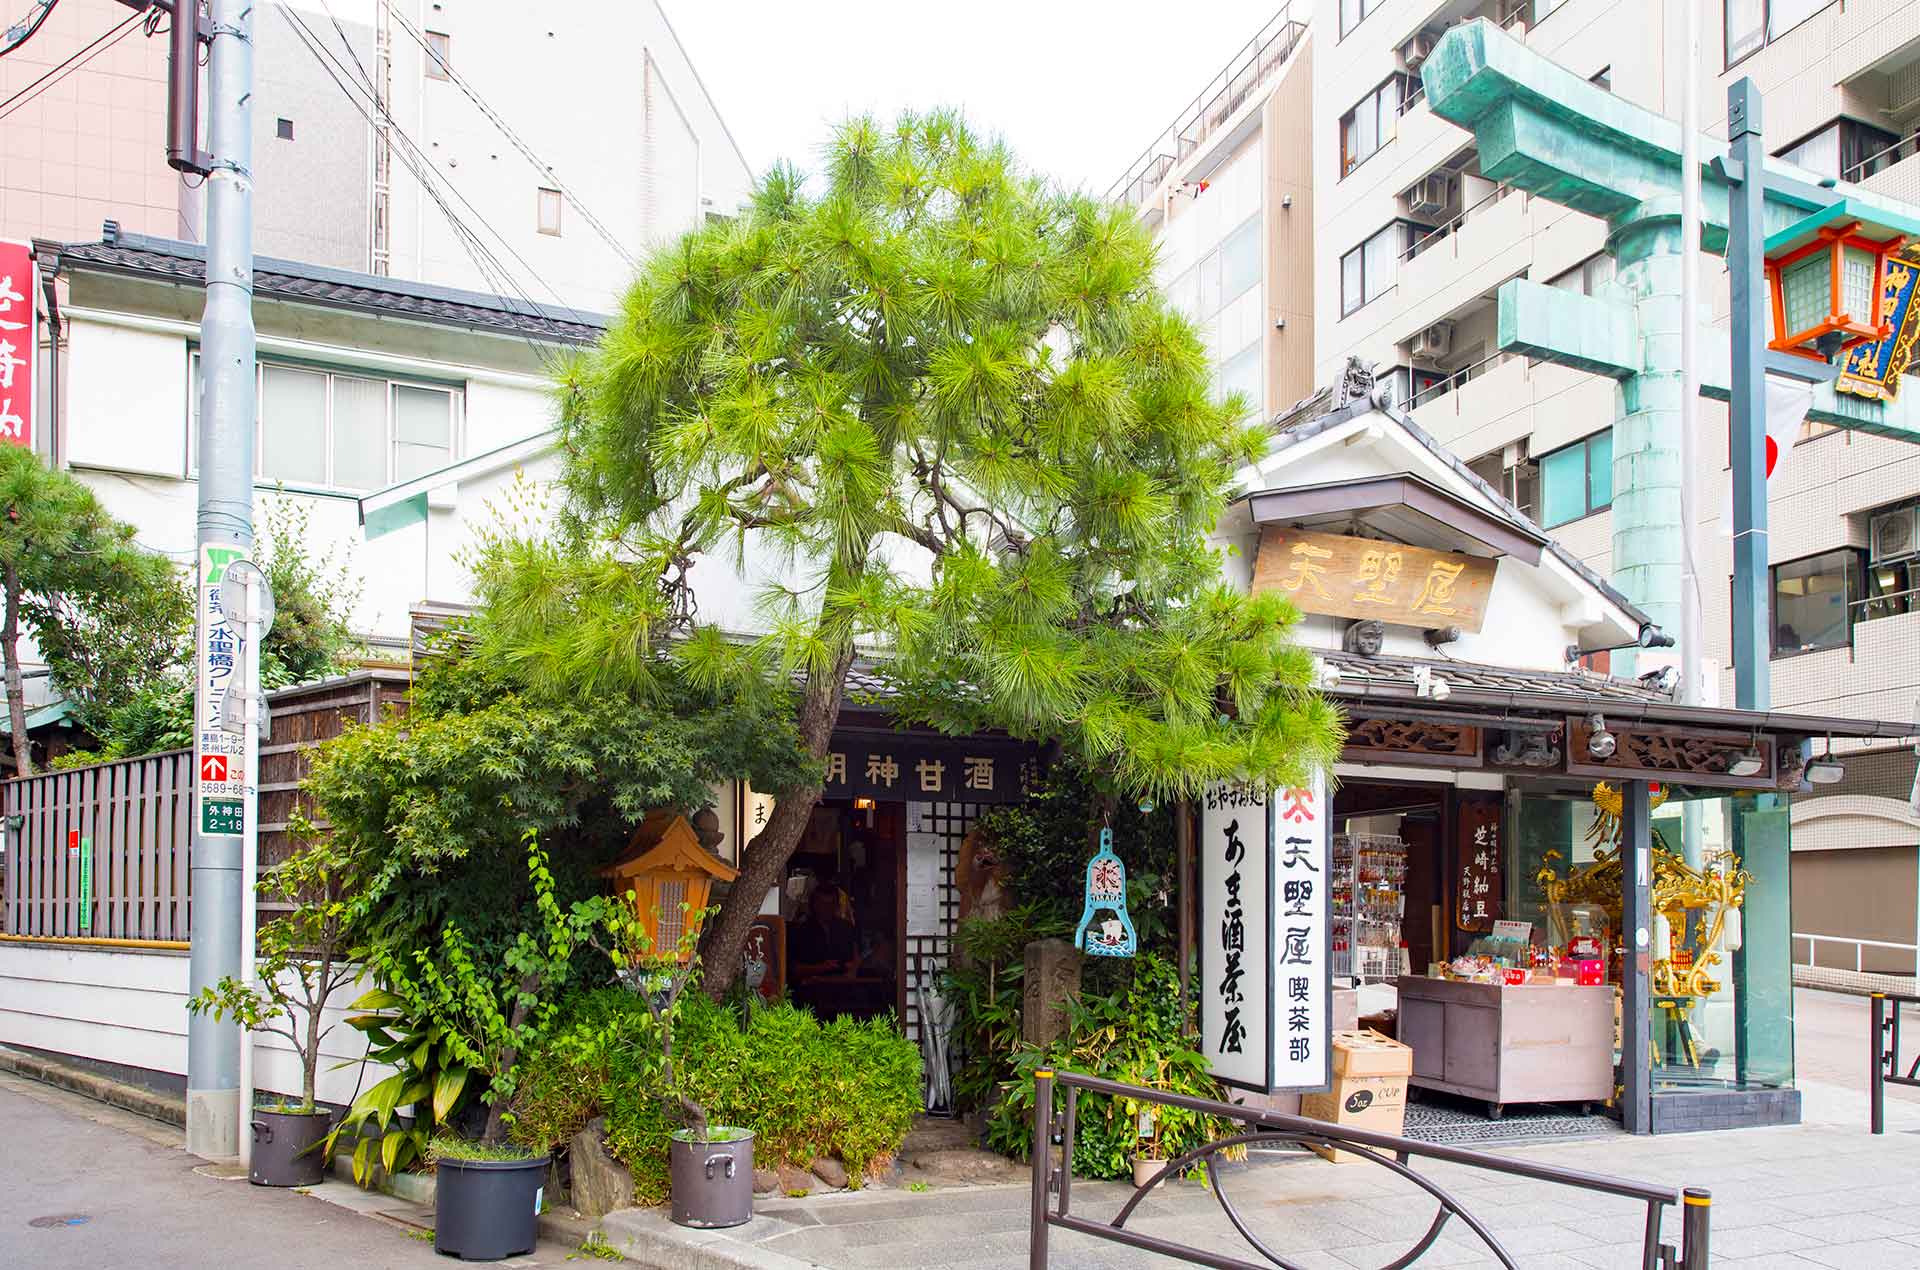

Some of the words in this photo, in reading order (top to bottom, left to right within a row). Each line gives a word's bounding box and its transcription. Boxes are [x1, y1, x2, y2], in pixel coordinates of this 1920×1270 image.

[209, 806, 243, 816] 外神田
[209, 819, 243, 830] 2-18
[1473, 825, 1489, 918] 芝崎納豆
[1288, 976, 1310, 1062] 喫茶部
